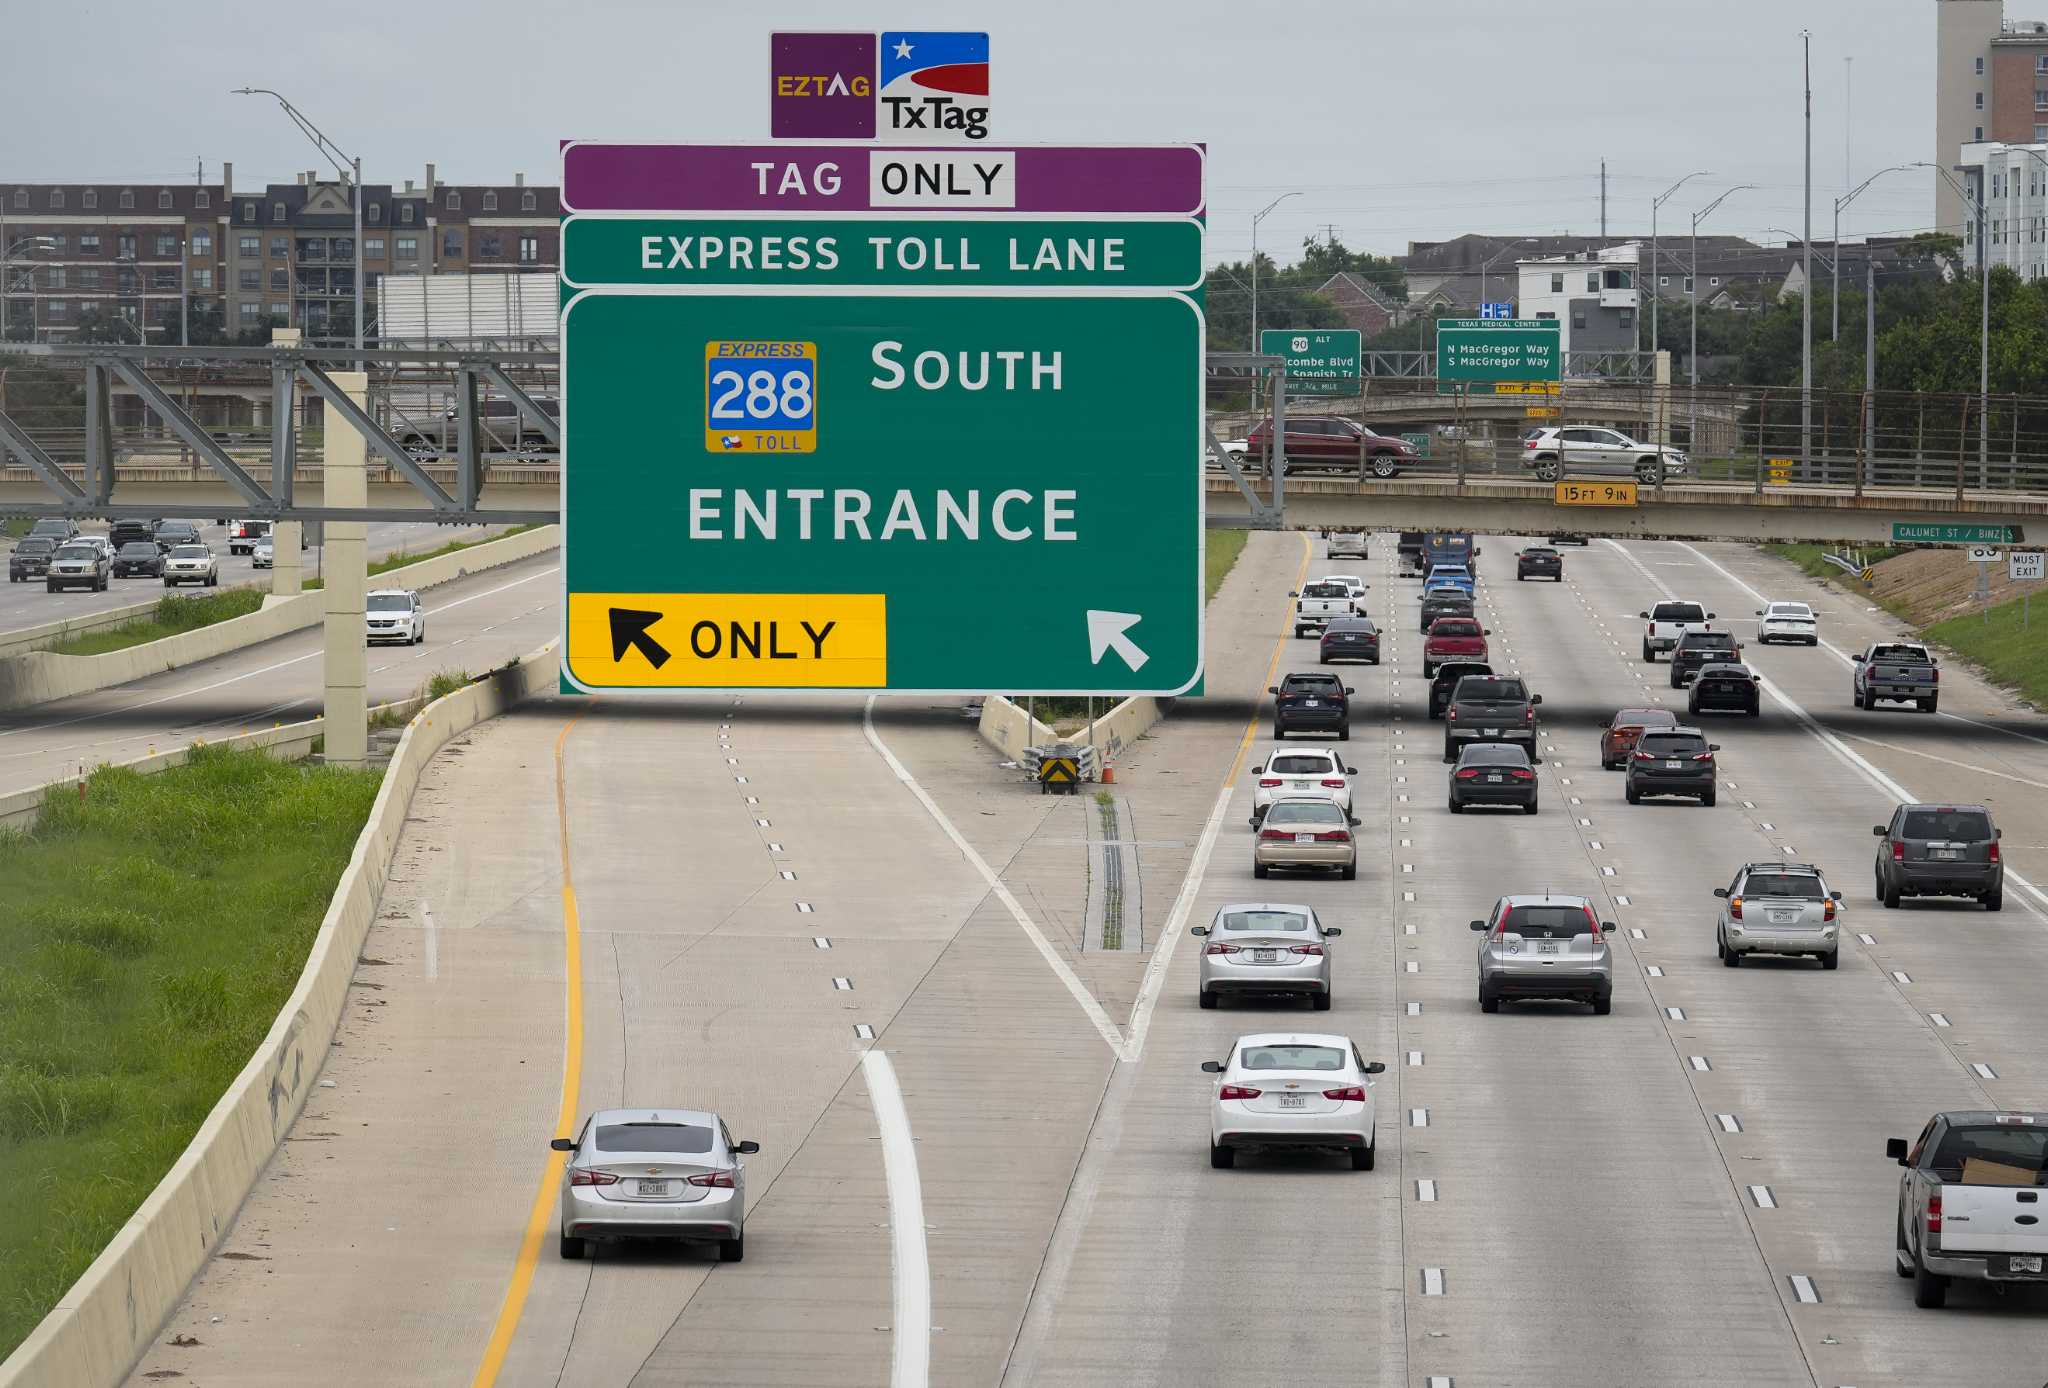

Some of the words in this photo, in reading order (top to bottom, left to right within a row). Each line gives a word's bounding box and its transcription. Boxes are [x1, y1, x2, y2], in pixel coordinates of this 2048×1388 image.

[778, 71, 870, 97] EZTAG
[881, 97, 989, 140] TxTag
[752, 162, 840, 196] TAG
[881, 162, 1004, 196] ONLY
[642, 236, 839, 270] EXPRESS
[868, 237, 980, 270] TOLL
[1009, 238, 1125, 271] LANE
[718, 343, 804, 357] EXPRESS
[1293, 340, 1307, 350] 90
[1315, 335, 1331, 343] ALT
[1447, 345, 1455, 353] N
[1460, 345, 1520, 355] MacGregor
[1526, 345, 1550, 355] Way
[871, 341, 1062, 390] SOUTH
[1329, 356, 1354, 366] Blvd
[1448, 357, 1455, 366] S
[1460, 357, 1520, 368] MacGregor
[1526, 357, 1550, 368] Way
[712, 370, 812, 419] 288
[754, 435, 802, 450] TOLL
[1565, 487, 1579, 500] 15
[689, 488, 1077, 541] ENTRANCE
[1899, 527, 1940, 537] CALUMET
[1947, 528, 1958, 538] ST
[1978, 529, 2001, 539] BINZ
[2013, 555, 2041, 564] MUST
[2016, 567, 2037, 576] EXIT
[690, 620, 836, 659] ONLY
